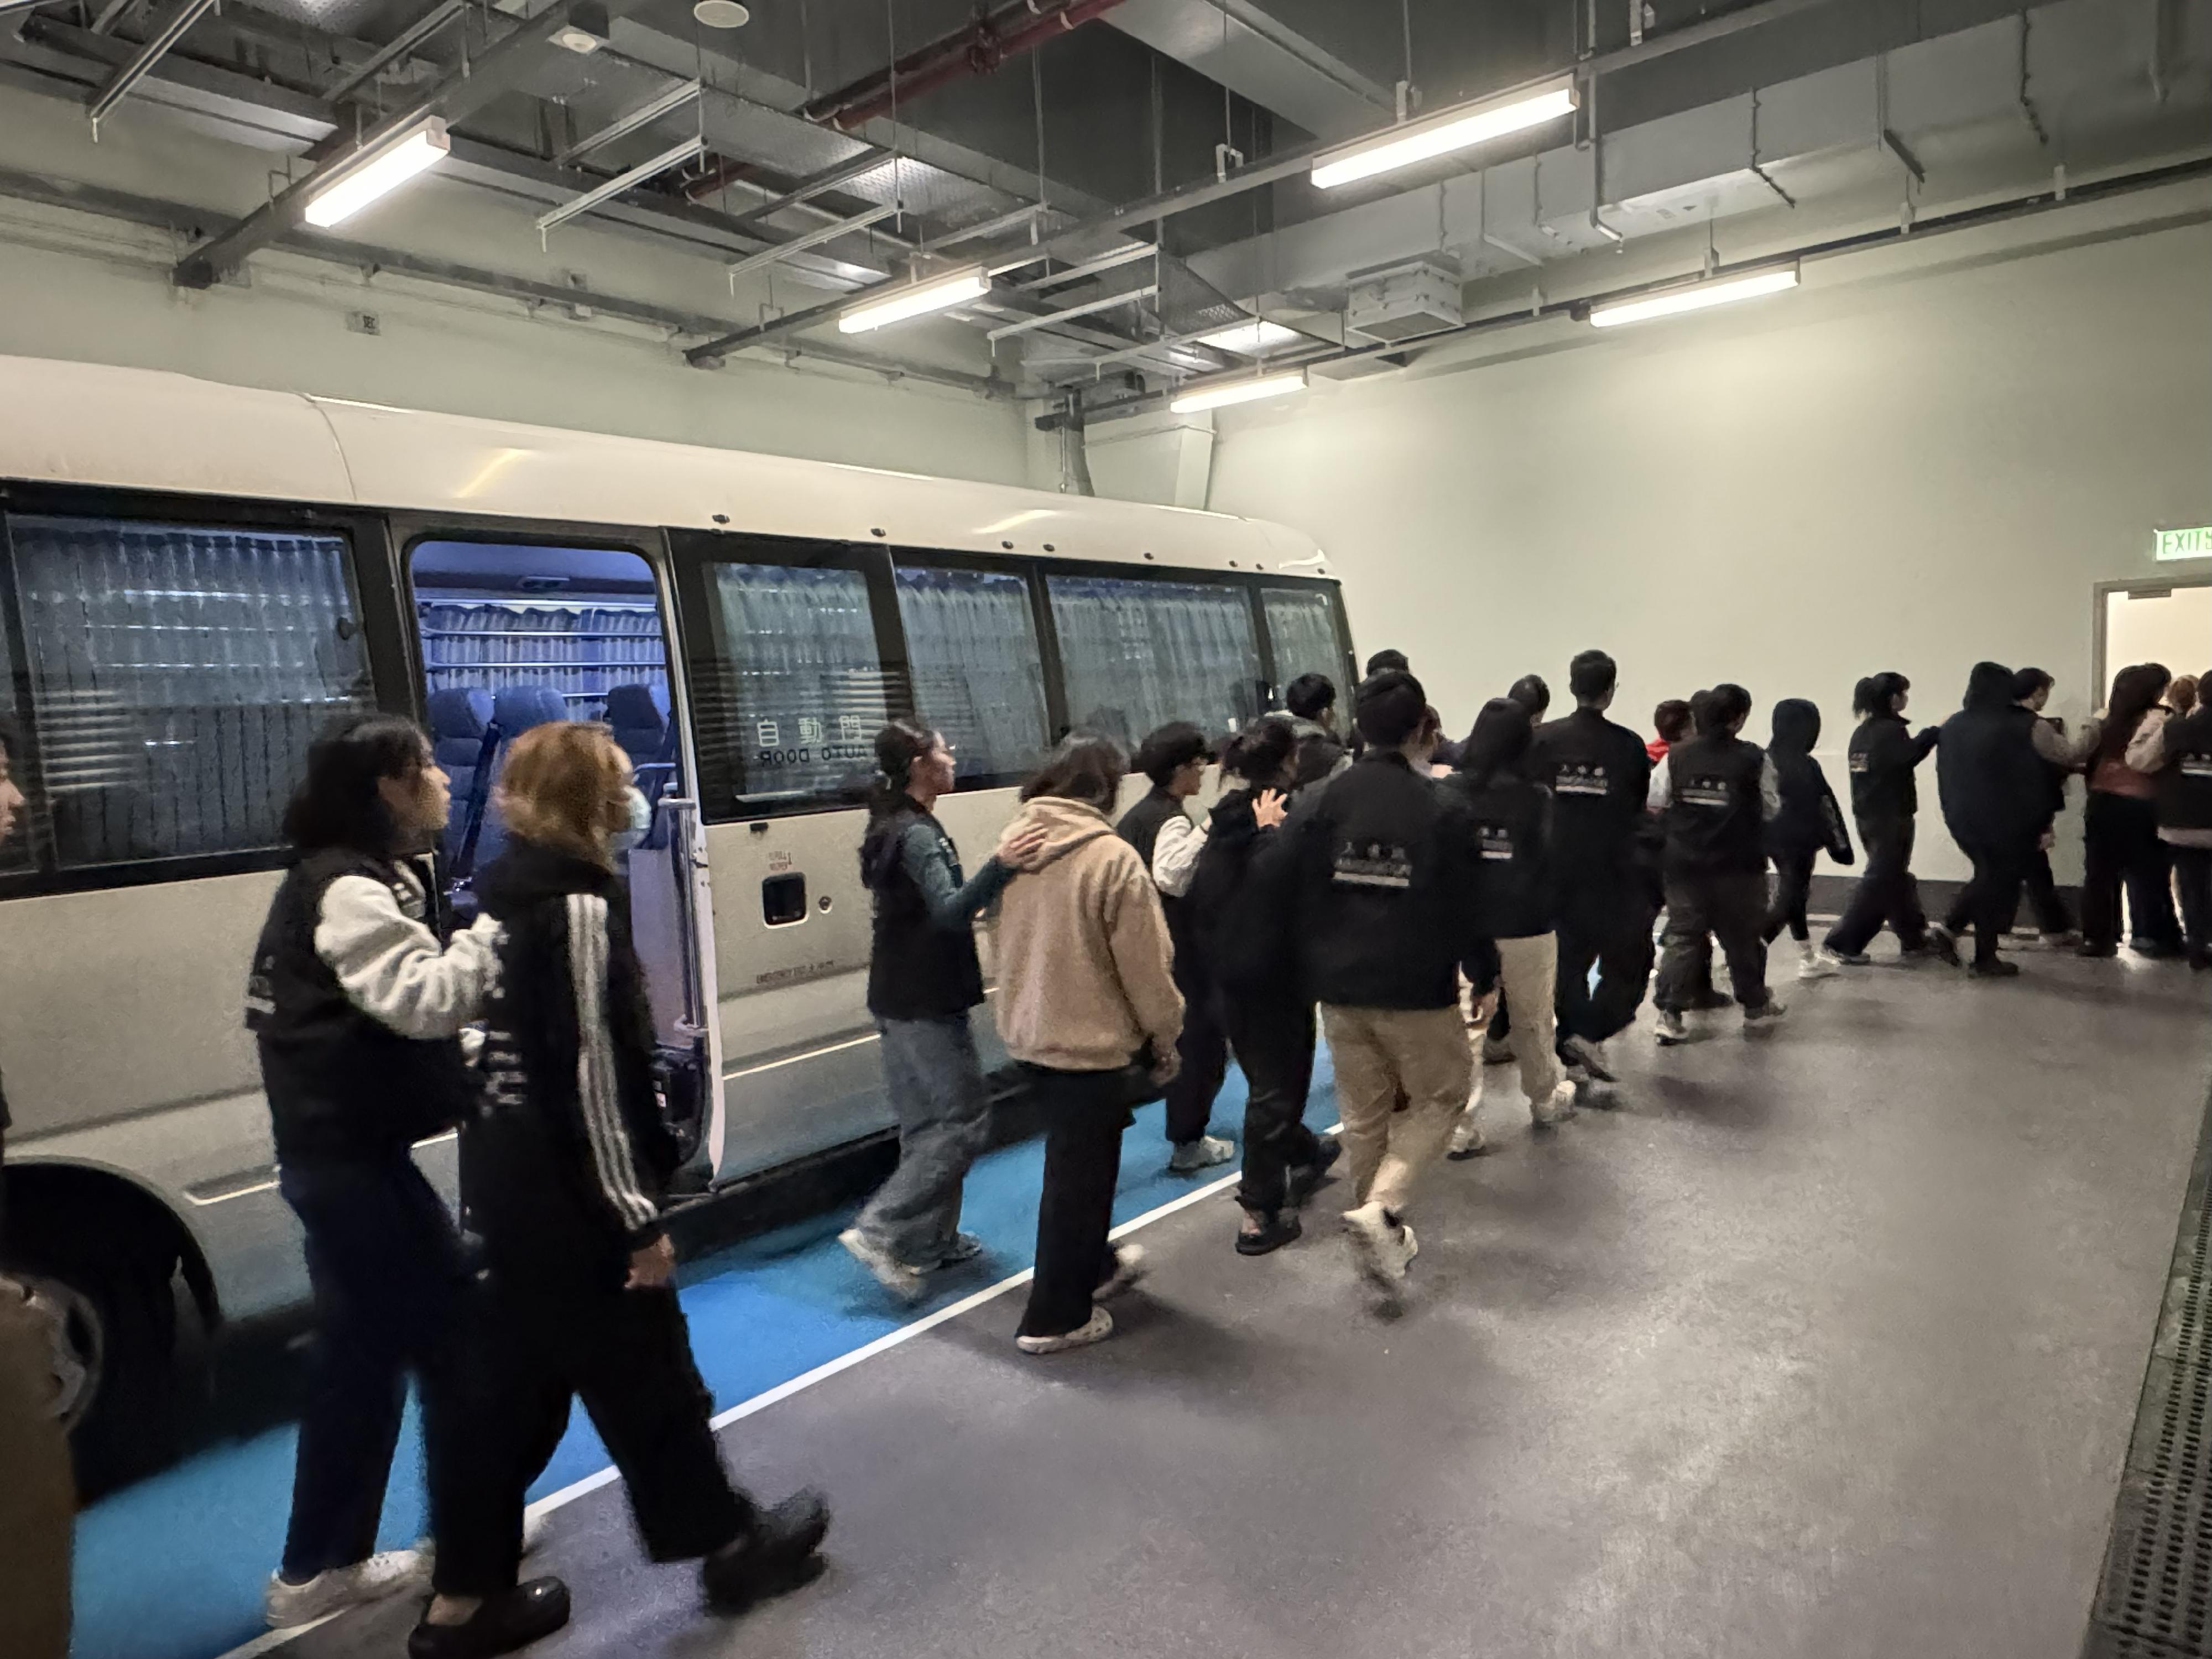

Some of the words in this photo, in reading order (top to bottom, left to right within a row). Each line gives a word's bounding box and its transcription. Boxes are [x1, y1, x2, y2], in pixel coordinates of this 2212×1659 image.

[2163, 531, 2201, 554] EXIT
[757, 715, 862, 747] 自動門
